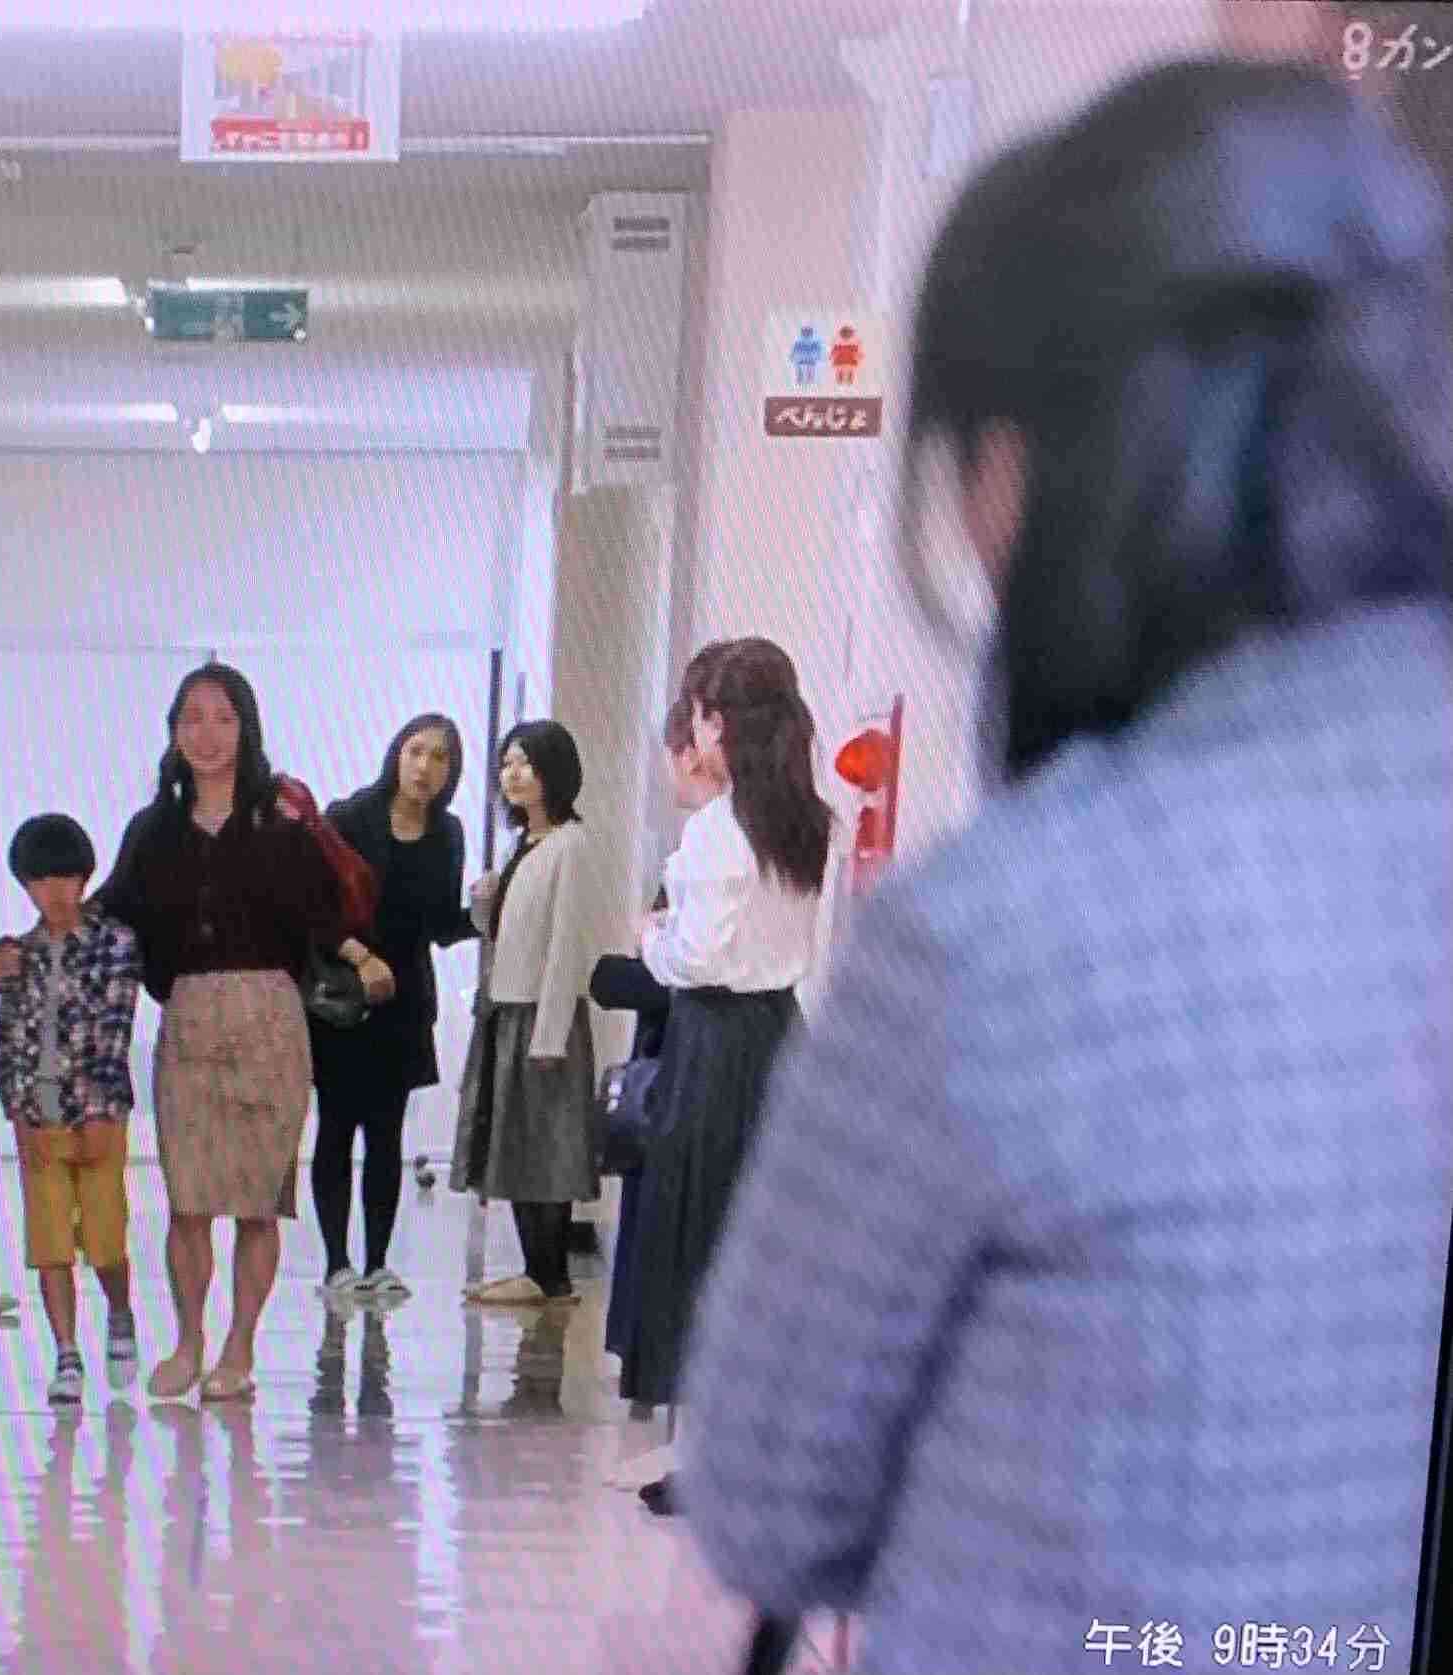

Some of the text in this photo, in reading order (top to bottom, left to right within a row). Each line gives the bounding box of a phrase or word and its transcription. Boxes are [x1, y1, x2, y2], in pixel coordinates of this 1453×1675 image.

[774, 403, 868, 431] べんじょ
[1083, 1618, 1392, 1671] 午後 9時34分
